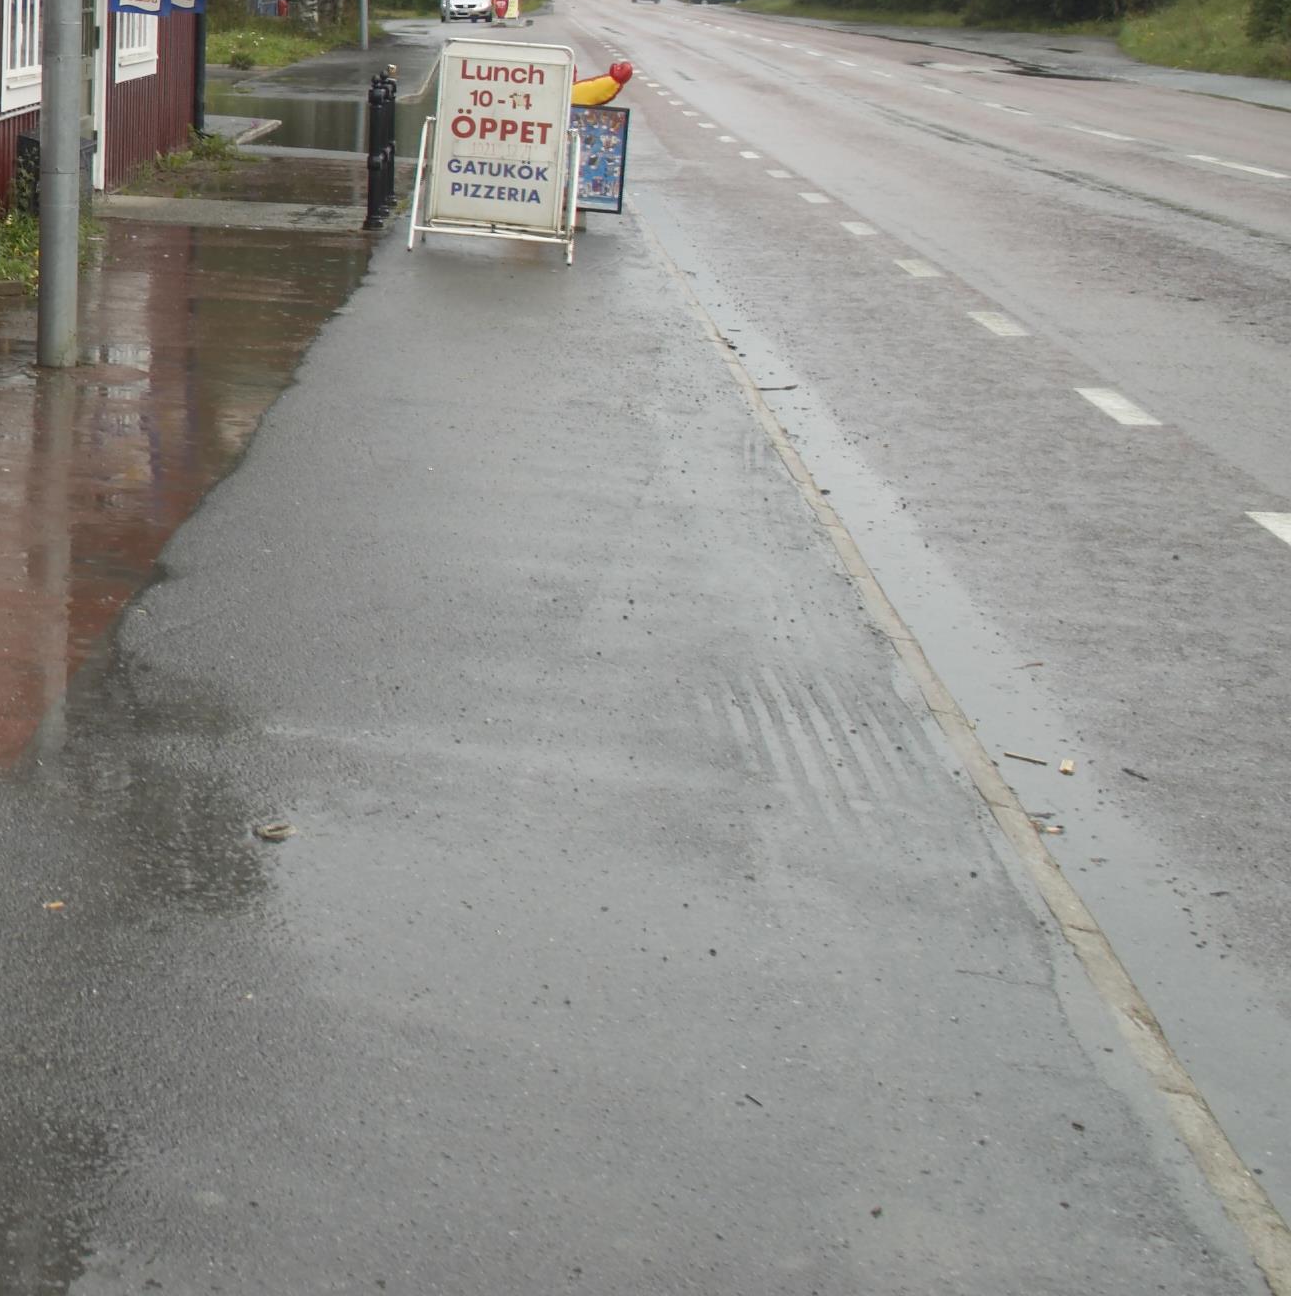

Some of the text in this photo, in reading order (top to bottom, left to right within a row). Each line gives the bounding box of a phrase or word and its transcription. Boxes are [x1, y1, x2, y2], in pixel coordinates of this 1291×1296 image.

[461, 59, 544, 85] Lunch
[451, 108, 553, 145] ÖPPET
[447, 158, 549, 181] GATUKÖK
[451, 182, 541, 204] PIZZERIA
